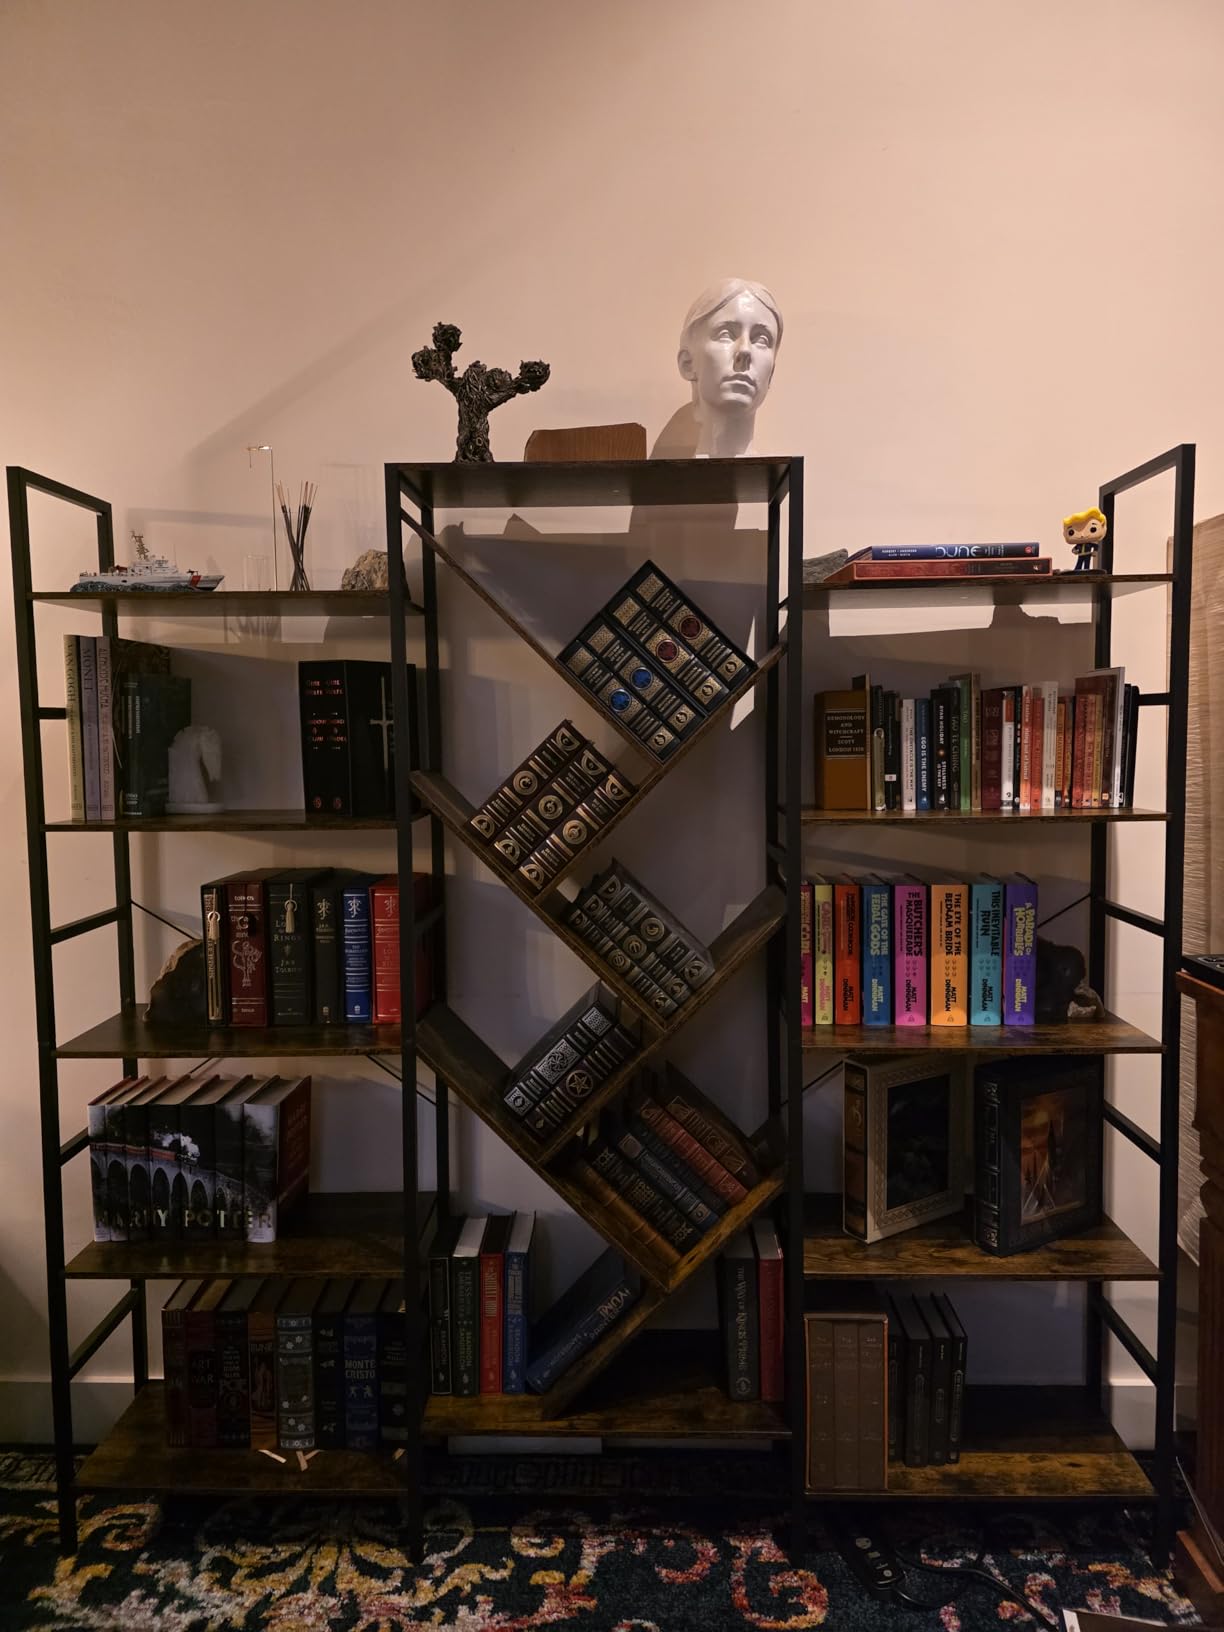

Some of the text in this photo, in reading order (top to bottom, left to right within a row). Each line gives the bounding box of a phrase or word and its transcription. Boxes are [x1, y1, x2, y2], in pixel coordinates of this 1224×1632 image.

[935, 546, 982, 558] DUNE
[83, 648, 93, 691] MONET
[952, 735, 958, 744] TE
[870, 894, 882, 956] FERAL GODS
[914, 899, 922, 956] BUTCHER'S
[945, 893, 953, 956] BEDLAM BRIDE
[955, 928, 961, 938] OF
[980, 910, 990, 936] RUIN
[991, 891, 1000, 956] THIS INEVITABLE
[1014, 908, 1025, 956] HORRIBLES
[1024, 909, 1035, 947] PARADE
[345, 1360, 376, 1368] MONTE
[345, 1370, 376, 1379] CRISTO
